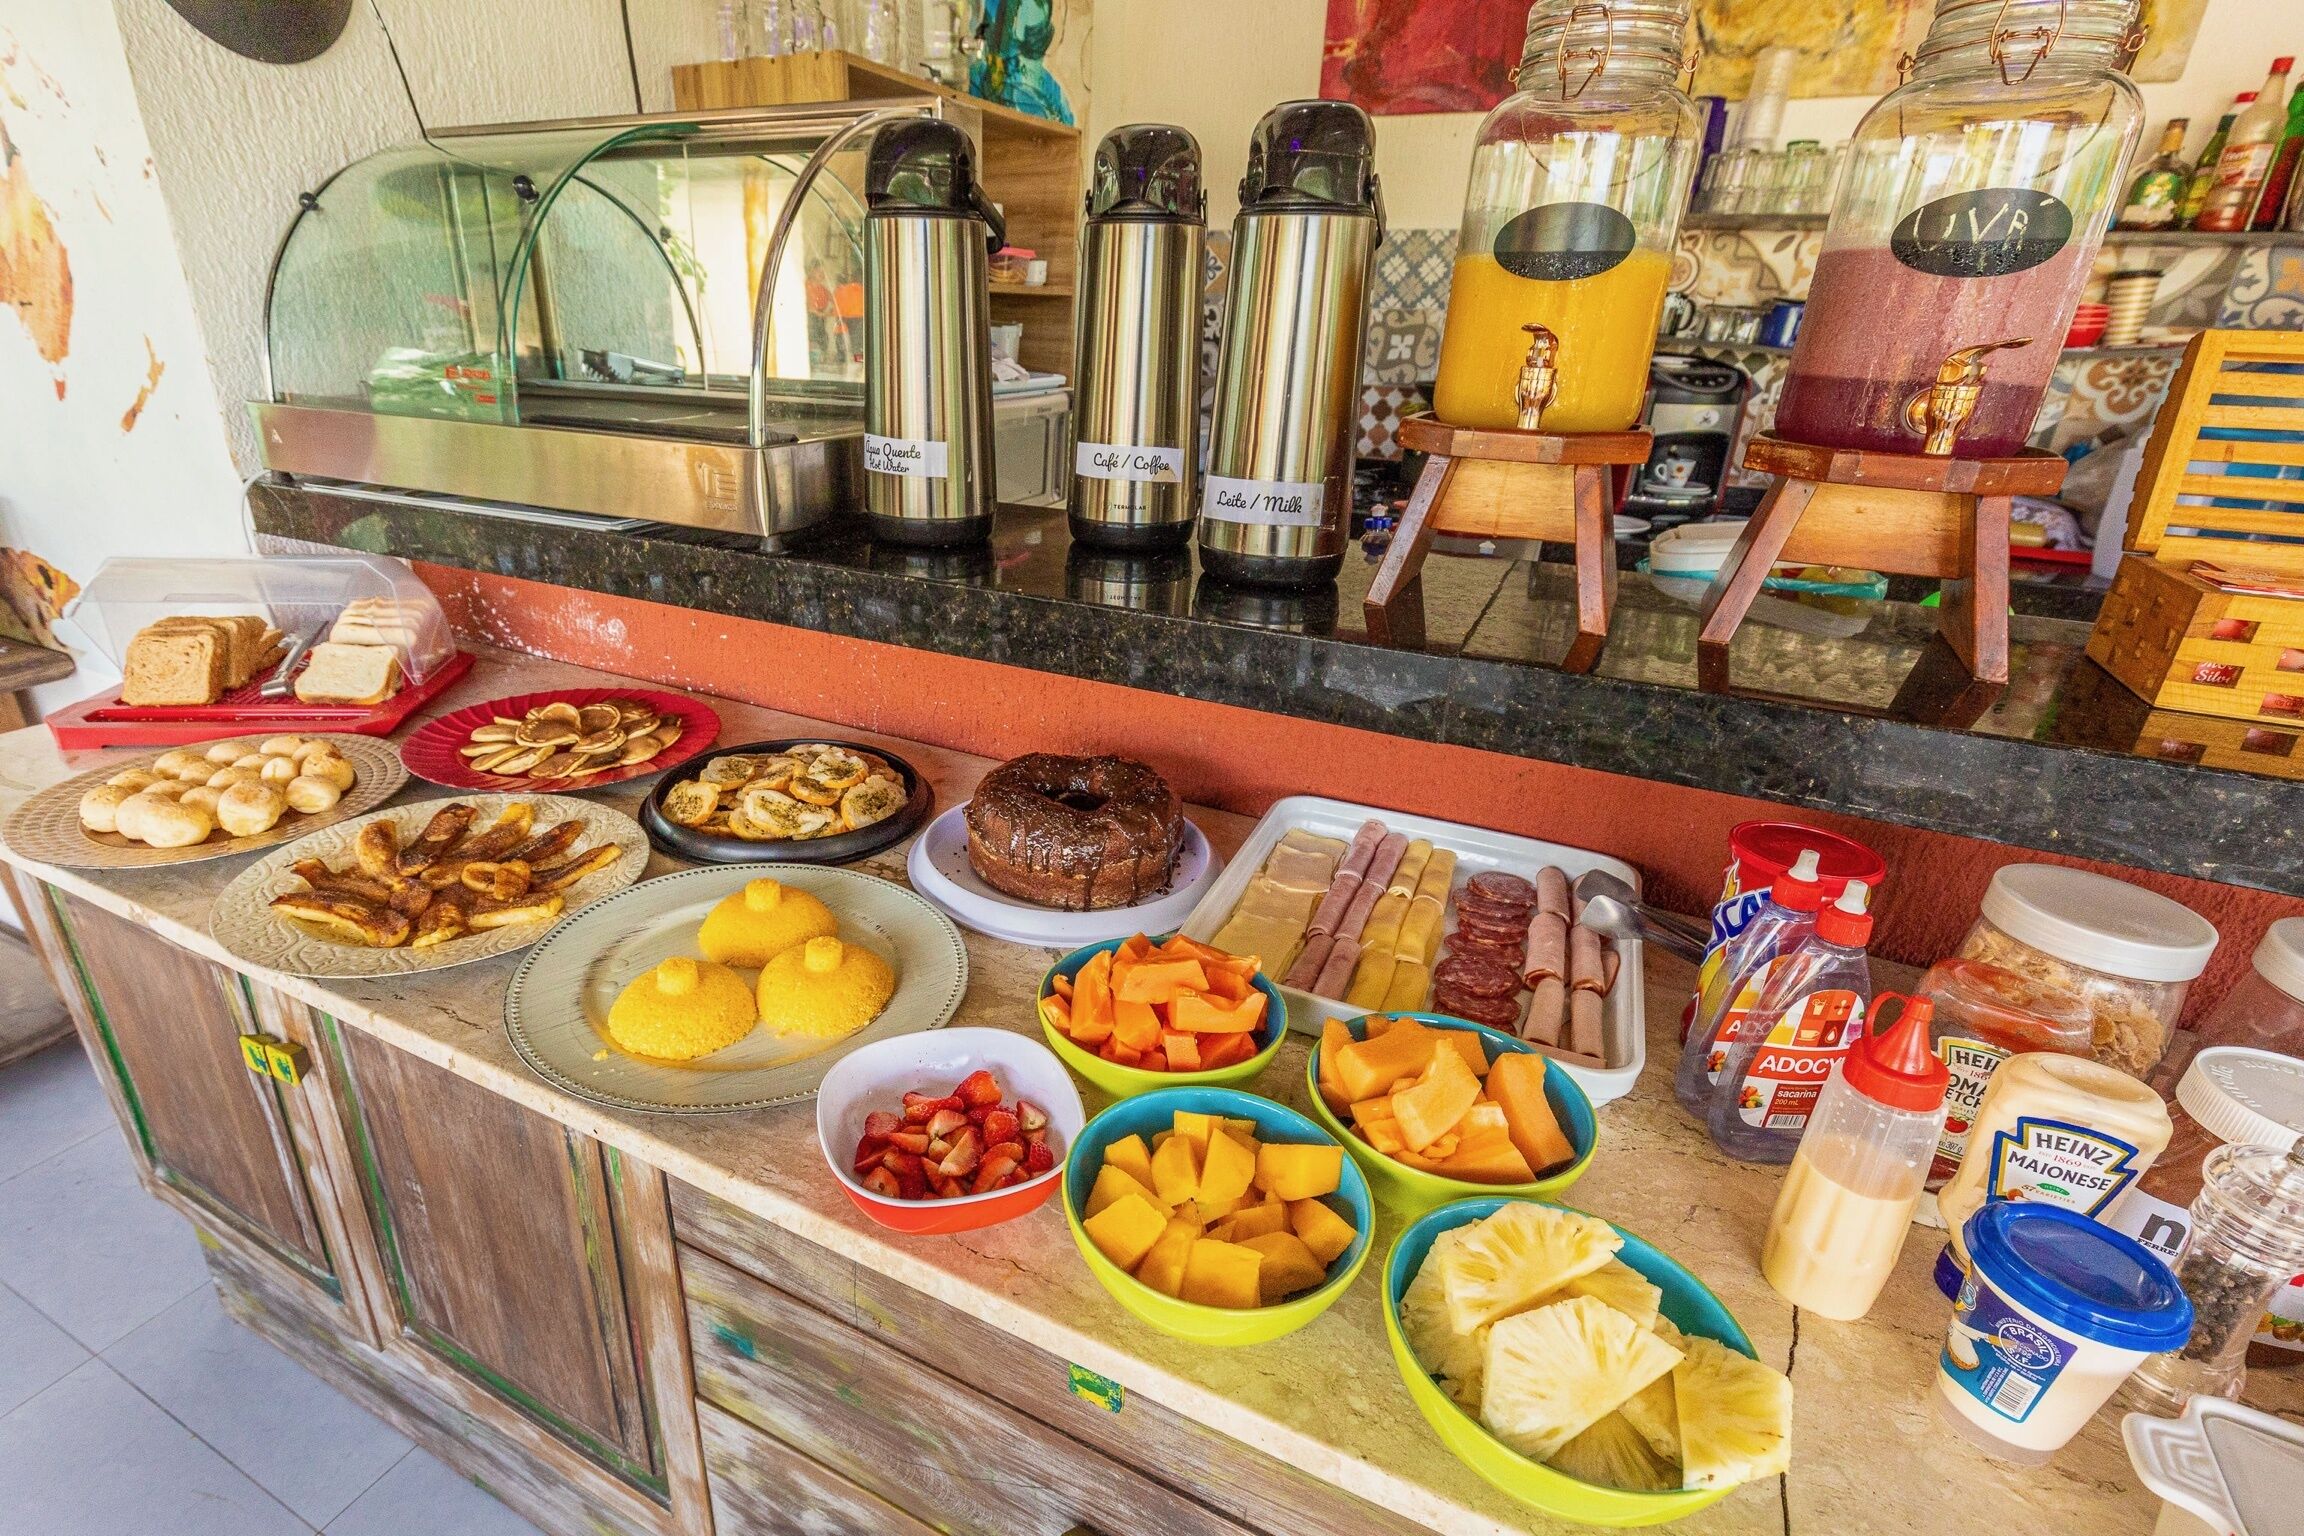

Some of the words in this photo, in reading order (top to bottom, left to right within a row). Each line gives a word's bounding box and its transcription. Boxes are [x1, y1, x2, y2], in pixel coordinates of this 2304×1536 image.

[883, 443, 921, 462] Quente
[870, 458, 881, 470] Hot
[883, 461, 909, 473] Water
[1094, 453, 1119, 472] Café
[1134, 455, 1169, 475] Coffee
[1217, 491, 1246, 508] Leite
[1264, 496, 1302, 513] Milk
[1758, 1055, 1846, 1074] ADOCY
[1969, 1070, 1991, 1080] 186
[1777, 1088, 1817, 1098] sacarina
[2036, 1132, 2112, 1165] HEINZ
[2054, 1155, 2082, 1167] 1869
[2008, 1151, 2111, 1191] MAIONESE
[2021, 1184, 2036, 1192] 57
[2026, 1323, 2036, 1332] DA
[2003, 1330, 2049, 1362] INSPECIONADO
[2009, 1327, 2049, 1354] BRASIL
